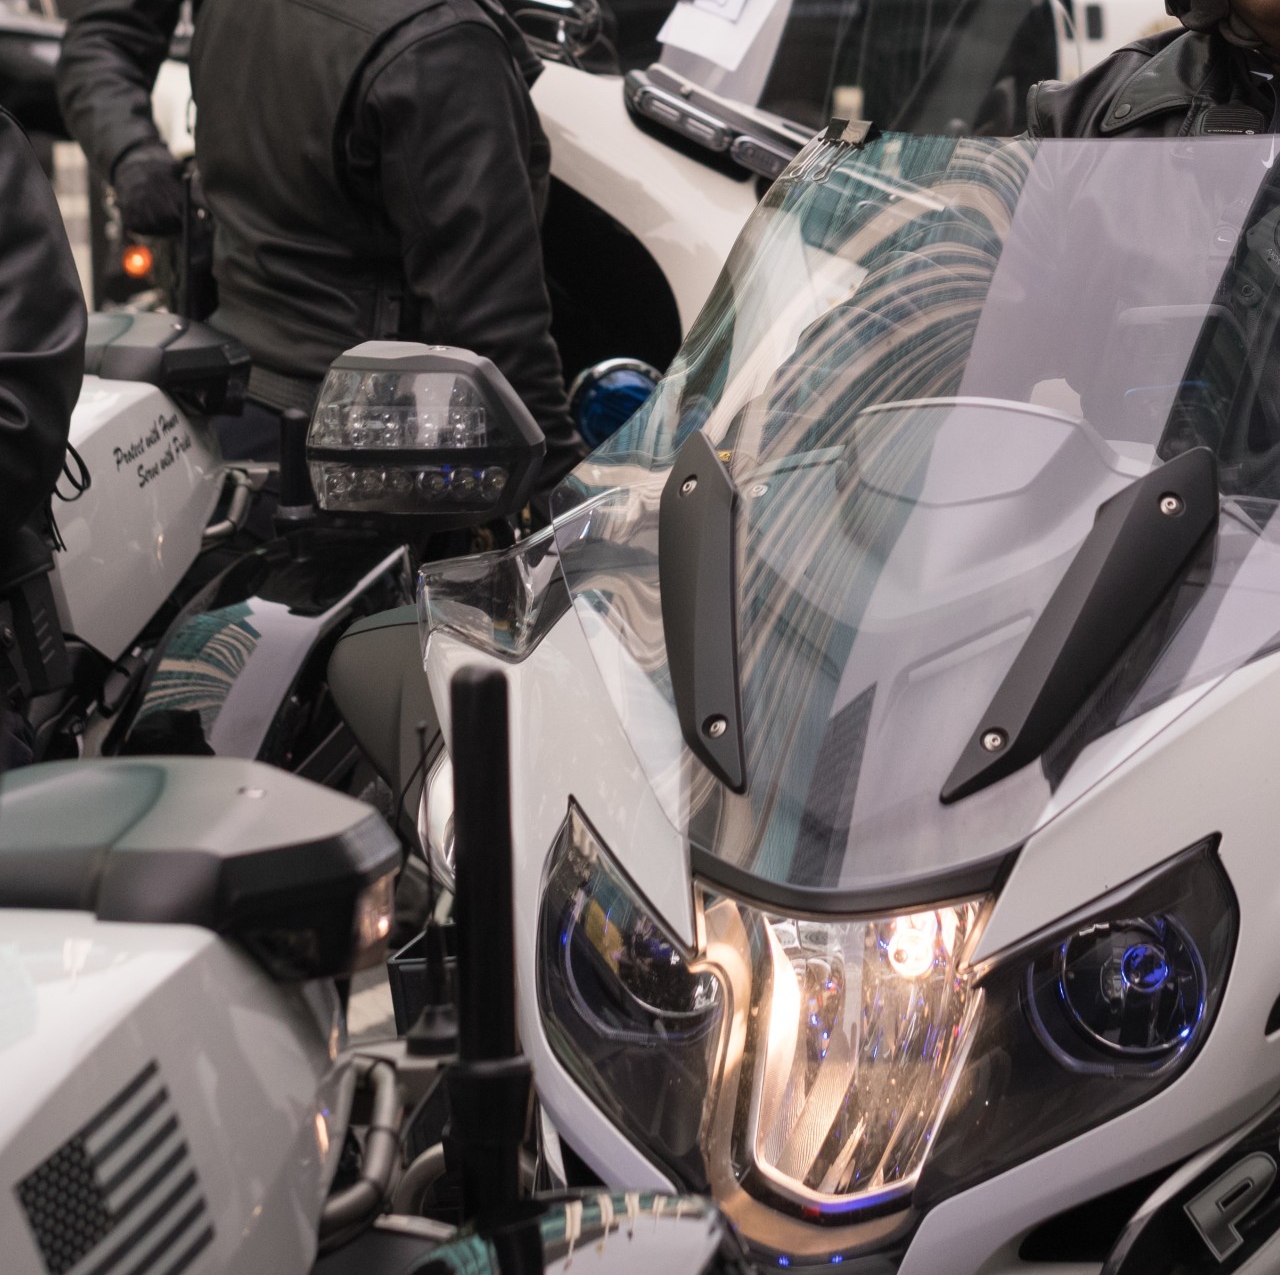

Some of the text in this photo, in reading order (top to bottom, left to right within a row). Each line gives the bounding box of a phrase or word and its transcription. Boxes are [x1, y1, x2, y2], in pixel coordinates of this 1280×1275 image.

[113, 413, 179, 472] Protect with Honor
[137, 431, 191, 488] Serve with Pride
